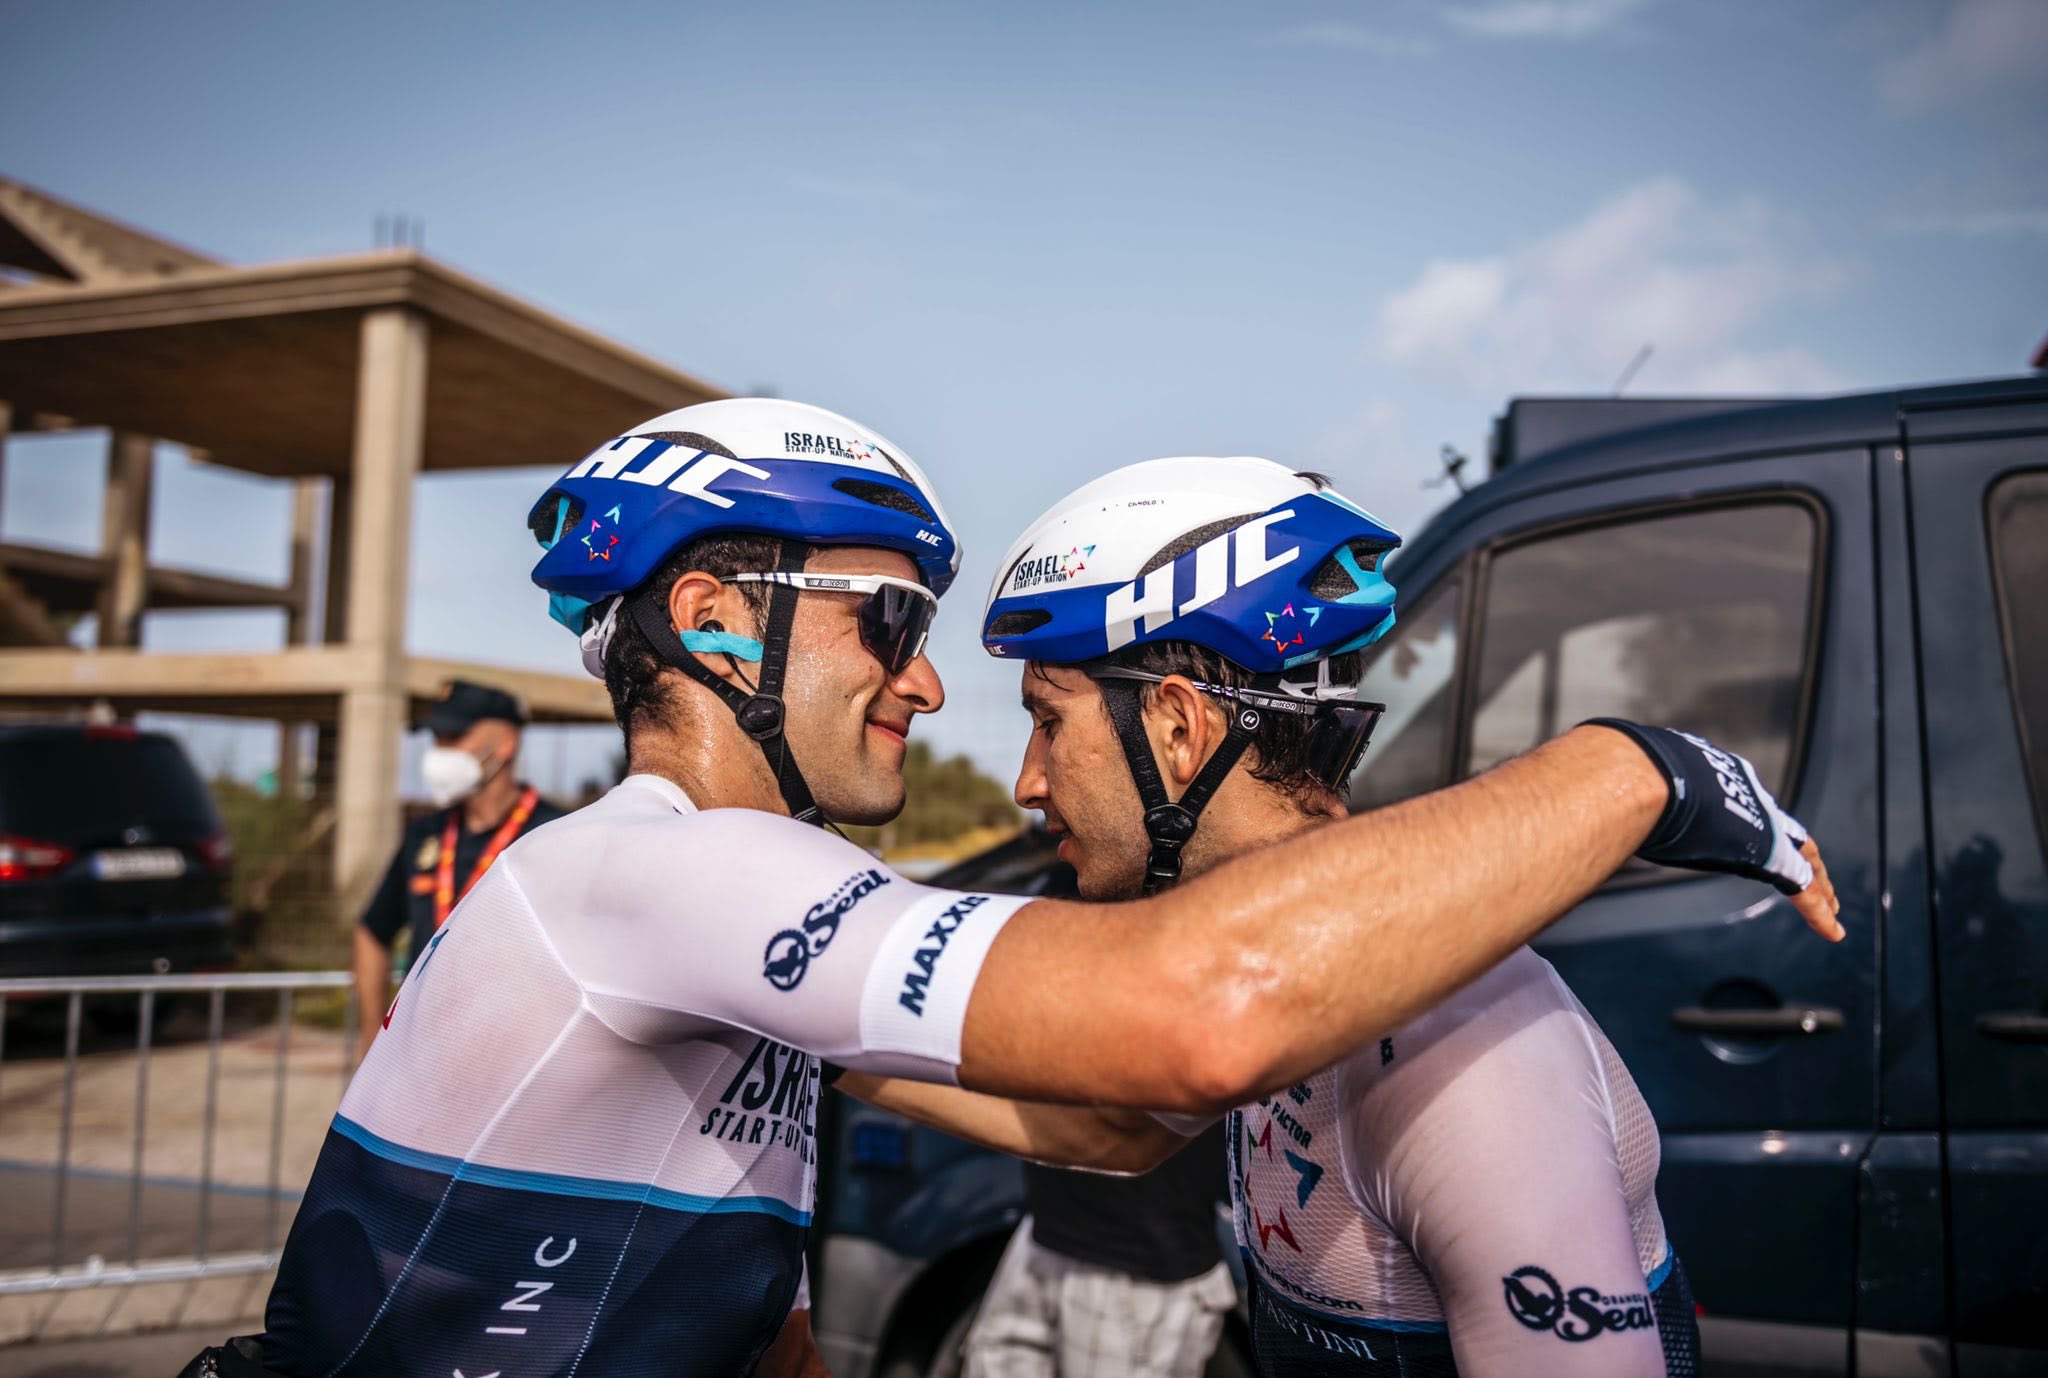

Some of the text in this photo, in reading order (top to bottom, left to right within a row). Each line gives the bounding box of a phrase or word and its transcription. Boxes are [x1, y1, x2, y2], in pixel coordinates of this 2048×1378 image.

[784, 431, 845, 452] ISRAEL
[785, 445, 856, 460] START-UP NATION
[566, 436, 771, 509] HJC
[915, 529, 942, 547] HJC
[1013, 572, 1068, 591] START-UP NATION
[1015, 555, 1059, 582] ISRAEL
[1106, 508, 1300, 652] HJC
[802, 869, 891, 958] Seal
[720, 1037, 818, 1137] ISRAE
[1272, 1101, 1312, 1150] FACTOR
[485, 1236, 577, 1335] INC
[1554, 1286, 1655, 1342] Seal
